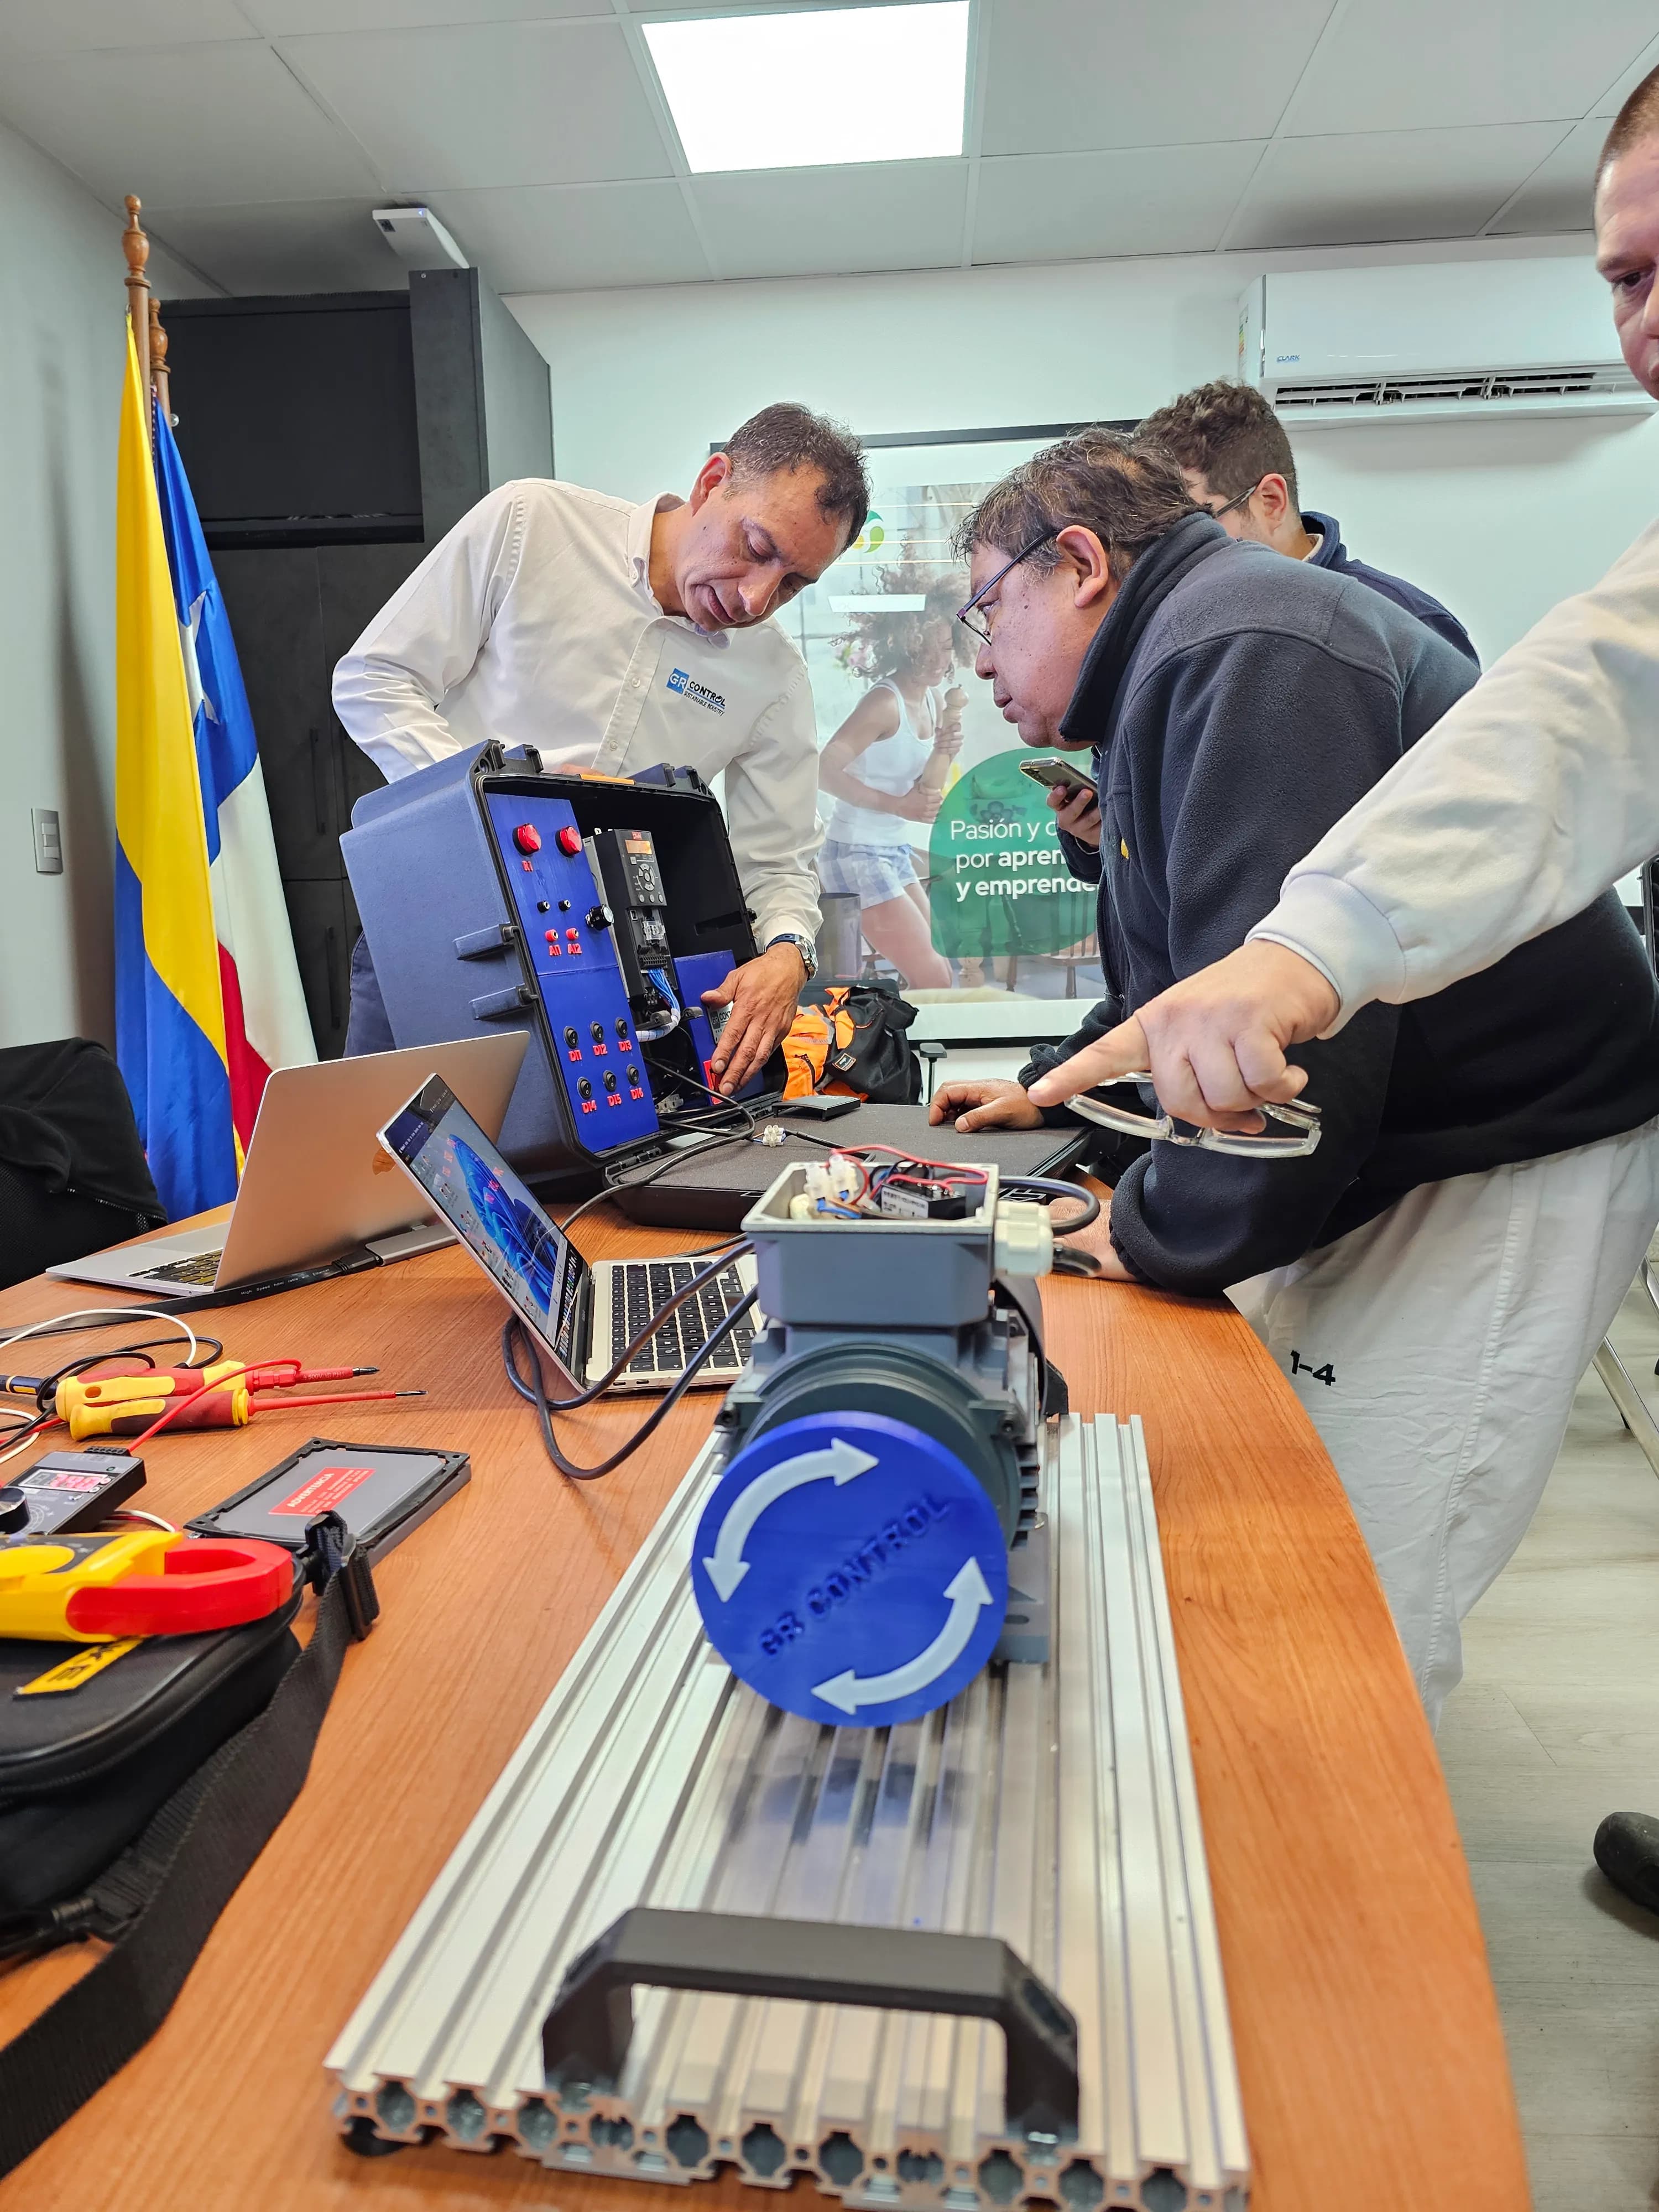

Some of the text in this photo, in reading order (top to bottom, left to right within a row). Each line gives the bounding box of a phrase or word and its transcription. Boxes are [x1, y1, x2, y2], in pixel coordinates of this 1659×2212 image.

[669, 673, 726, 707] GR CONTROL
[684, 690, 726, 717] SUSTAINABLE INDUSTRY
[951, 818, 1022, 840] Pasión
[1027, 822, 1040, 842] y
[956, 853, 994, 874] por
[955, 881, 971, 902] y
[567, 943, 582, 955] AI2
[568, 1040, 633, 1062] DI1 DI2 DI3
[581, 1087, 644, 1114] DI4 DI5 DI6
[1290, 1349, 1336, 1386] 1-4
[286, 1473, 335, 1507] ADVERTENCIA
[760, 1492, 951, 1655] GR CONTROL
